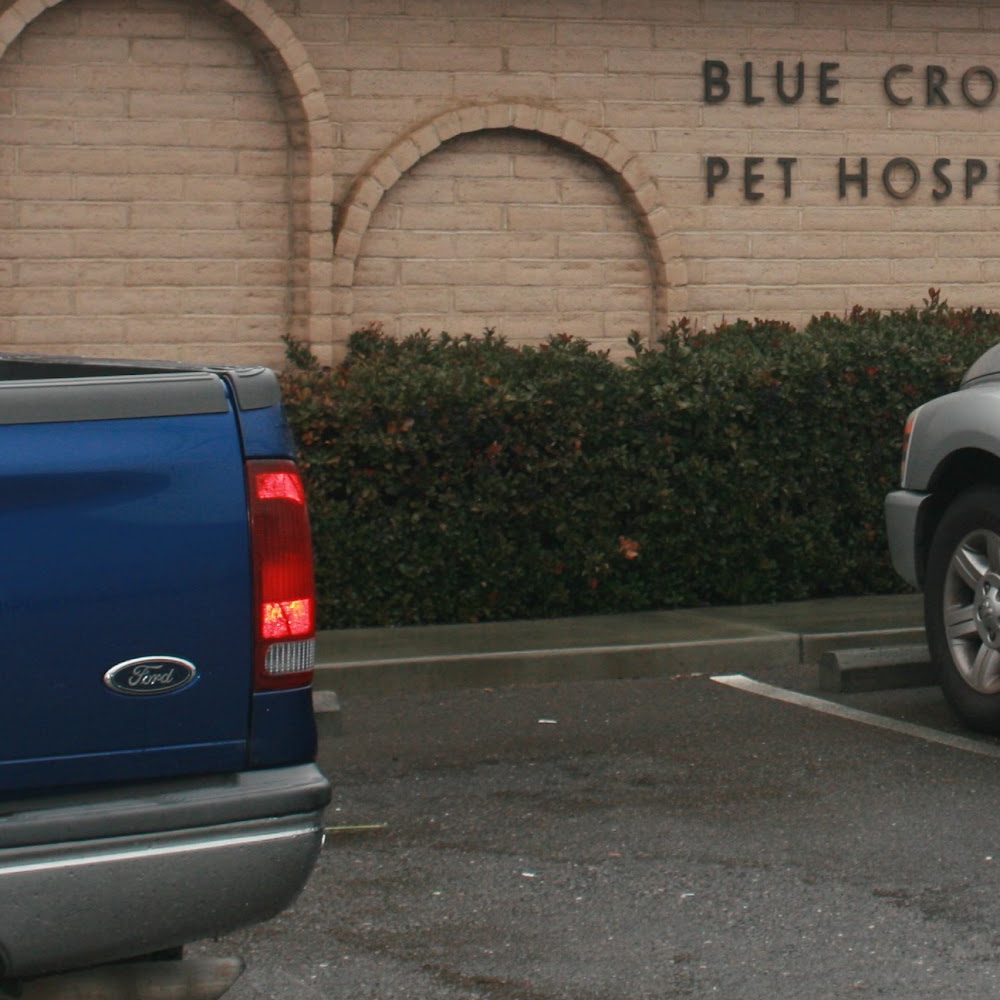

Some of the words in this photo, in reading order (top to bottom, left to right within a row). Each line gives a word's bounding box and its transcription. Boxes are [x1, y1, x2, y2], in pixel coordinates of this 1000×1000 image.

[704, 60, 840, 106] BLUE
[706, 156, 798, 200] PET
[128, 664, 175, 687] Ford
